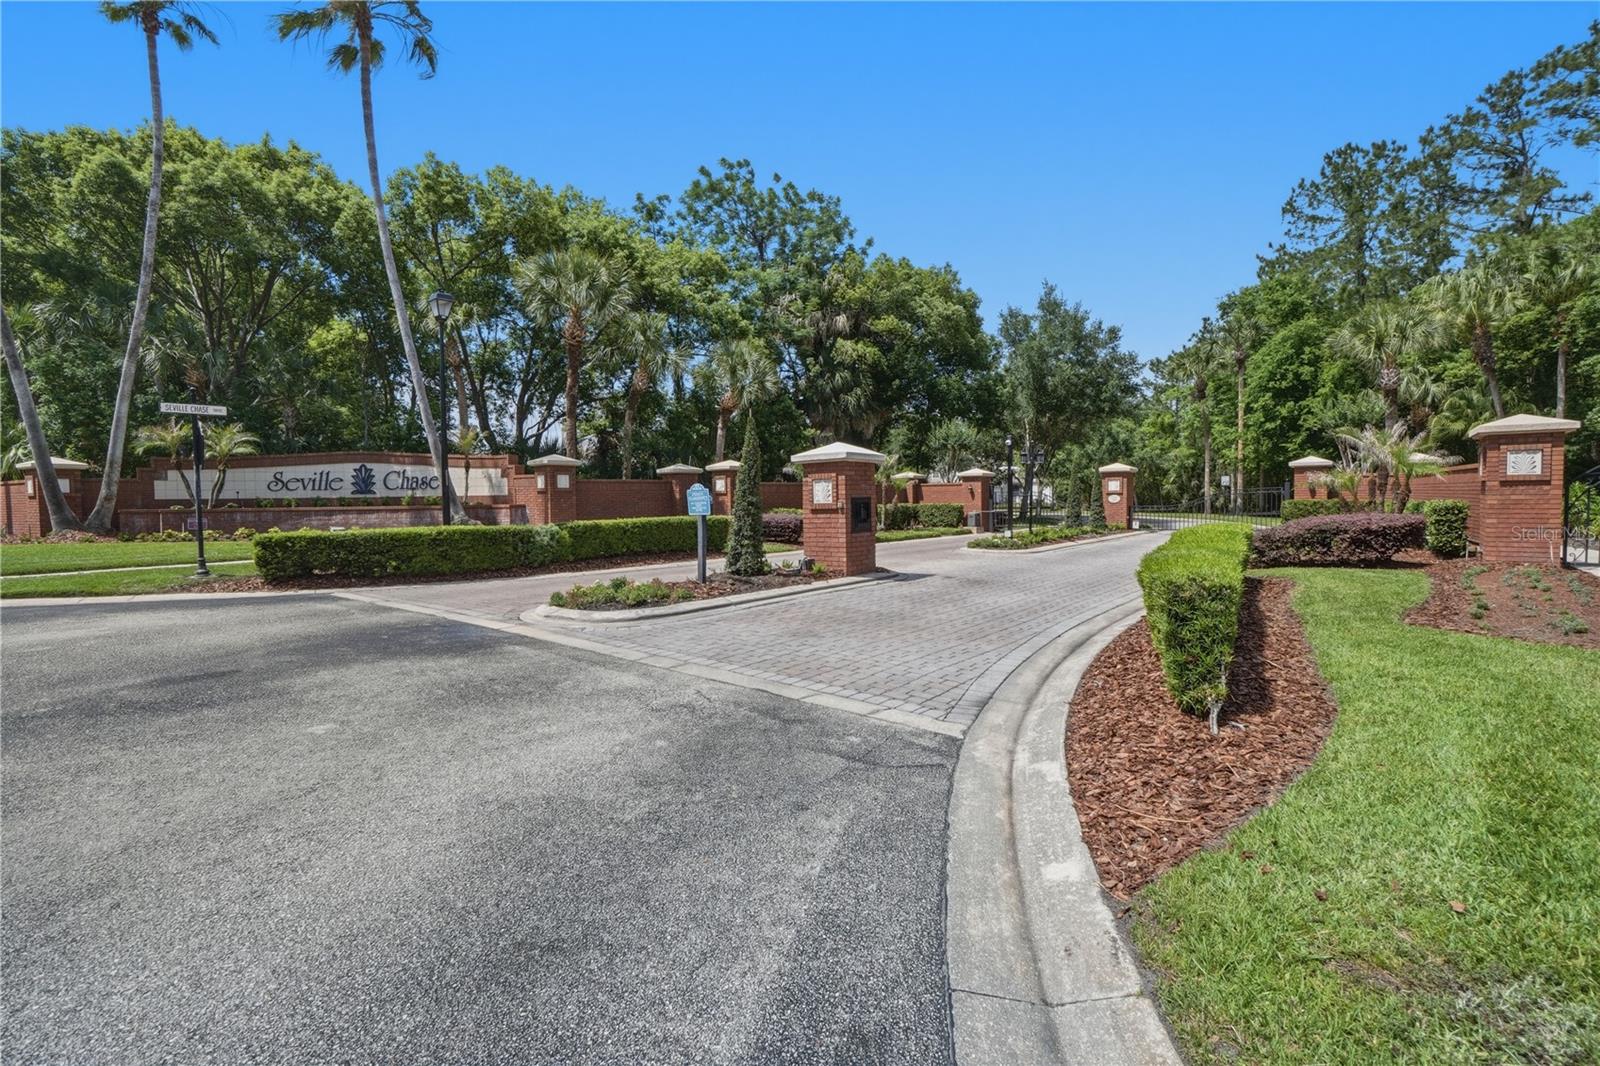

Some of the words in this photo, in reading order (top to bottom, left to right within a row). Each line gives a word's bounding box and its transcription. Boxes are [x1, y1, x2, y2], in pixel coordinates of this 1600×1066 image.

[164, 404, 188, 412] SEVILLE
[190, 406, 209, 414] CHASE
[267, 471, 344, 492] Seville
[383, 469, 440, 490] Chase
